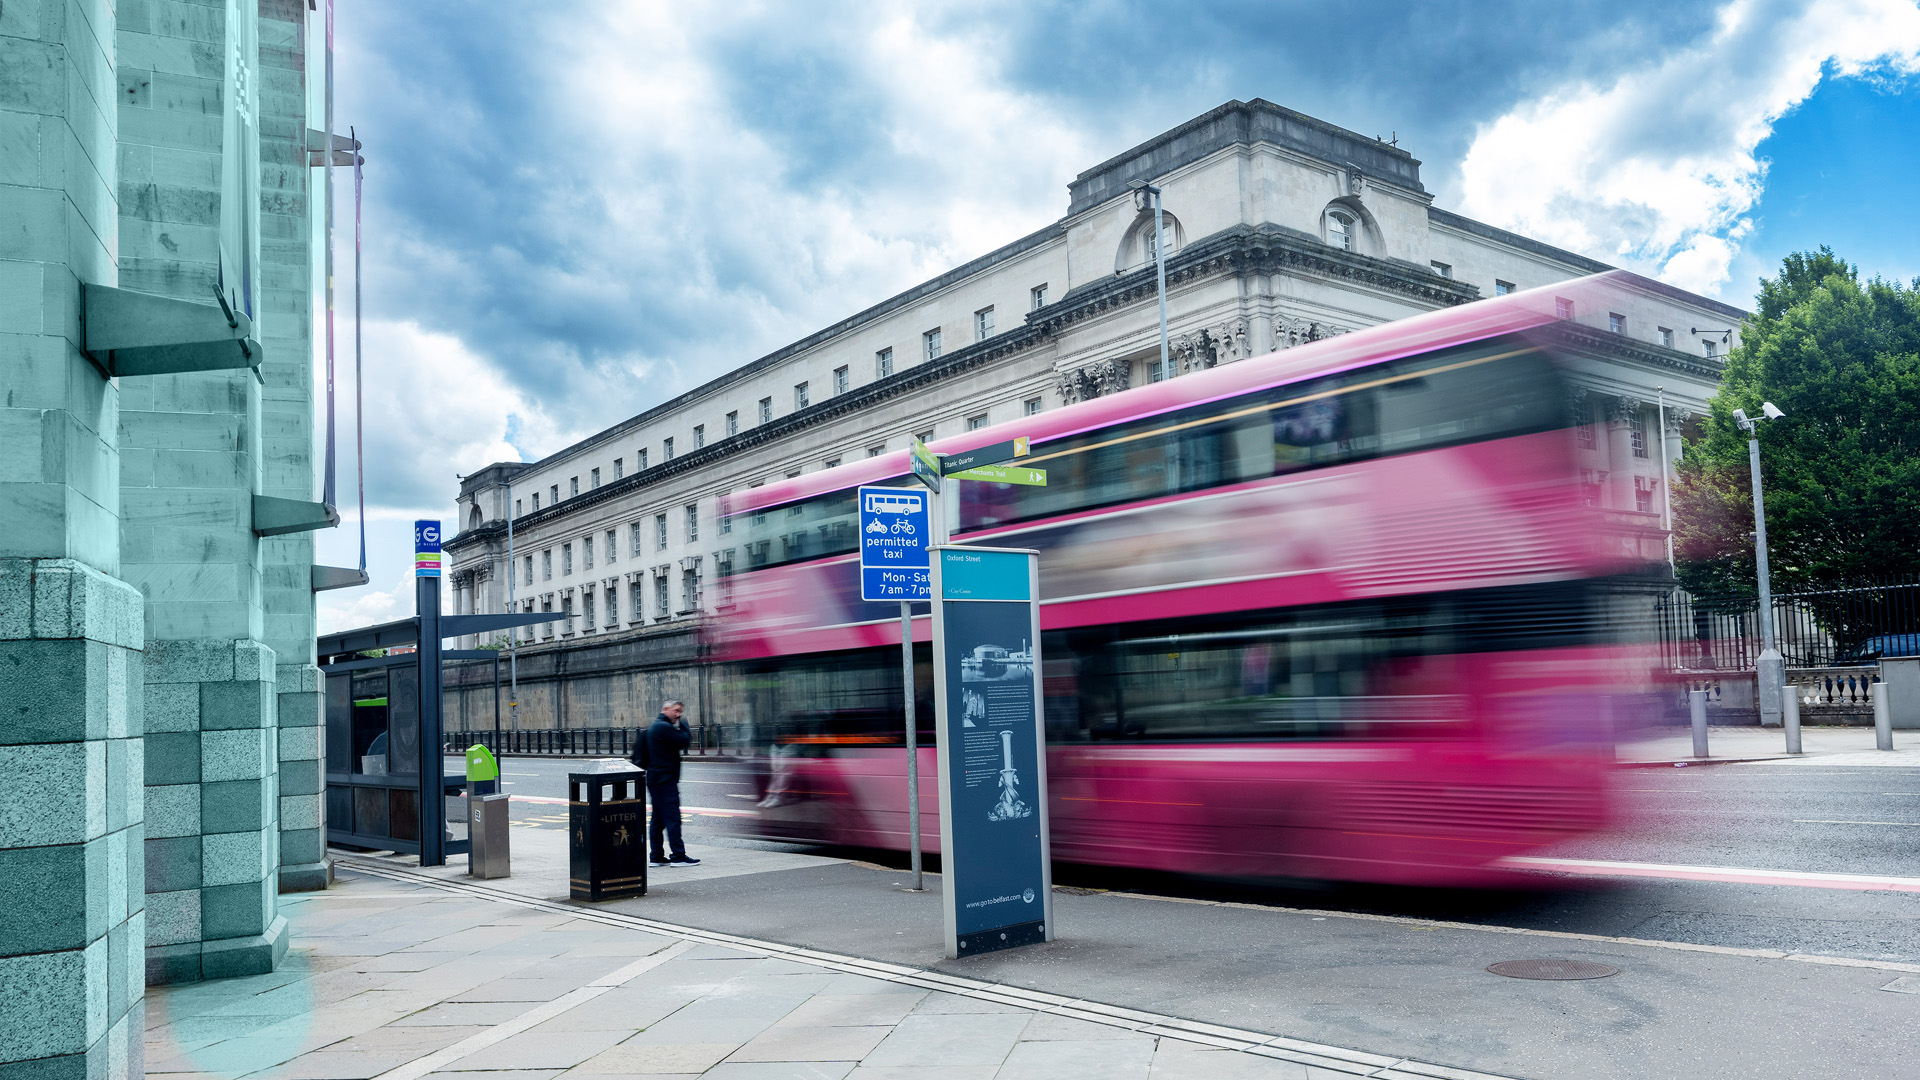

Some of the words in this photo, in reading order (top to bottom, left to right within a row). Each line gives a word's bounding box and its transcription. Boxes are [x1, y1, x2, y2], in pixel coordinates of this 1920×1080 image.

[944, 460, 957, 468] Titanic
[958, 456, 974, 466] Quarter
[969, 469, 994, 477] Merchants
[995, 470, 1006, 478] Trail
[867, 537, 918, 548] permitted
[883, 549, 903, 559] taxi
[946, 554, 964, 562] Oxford
[883, 572, 906, 582] Mon
